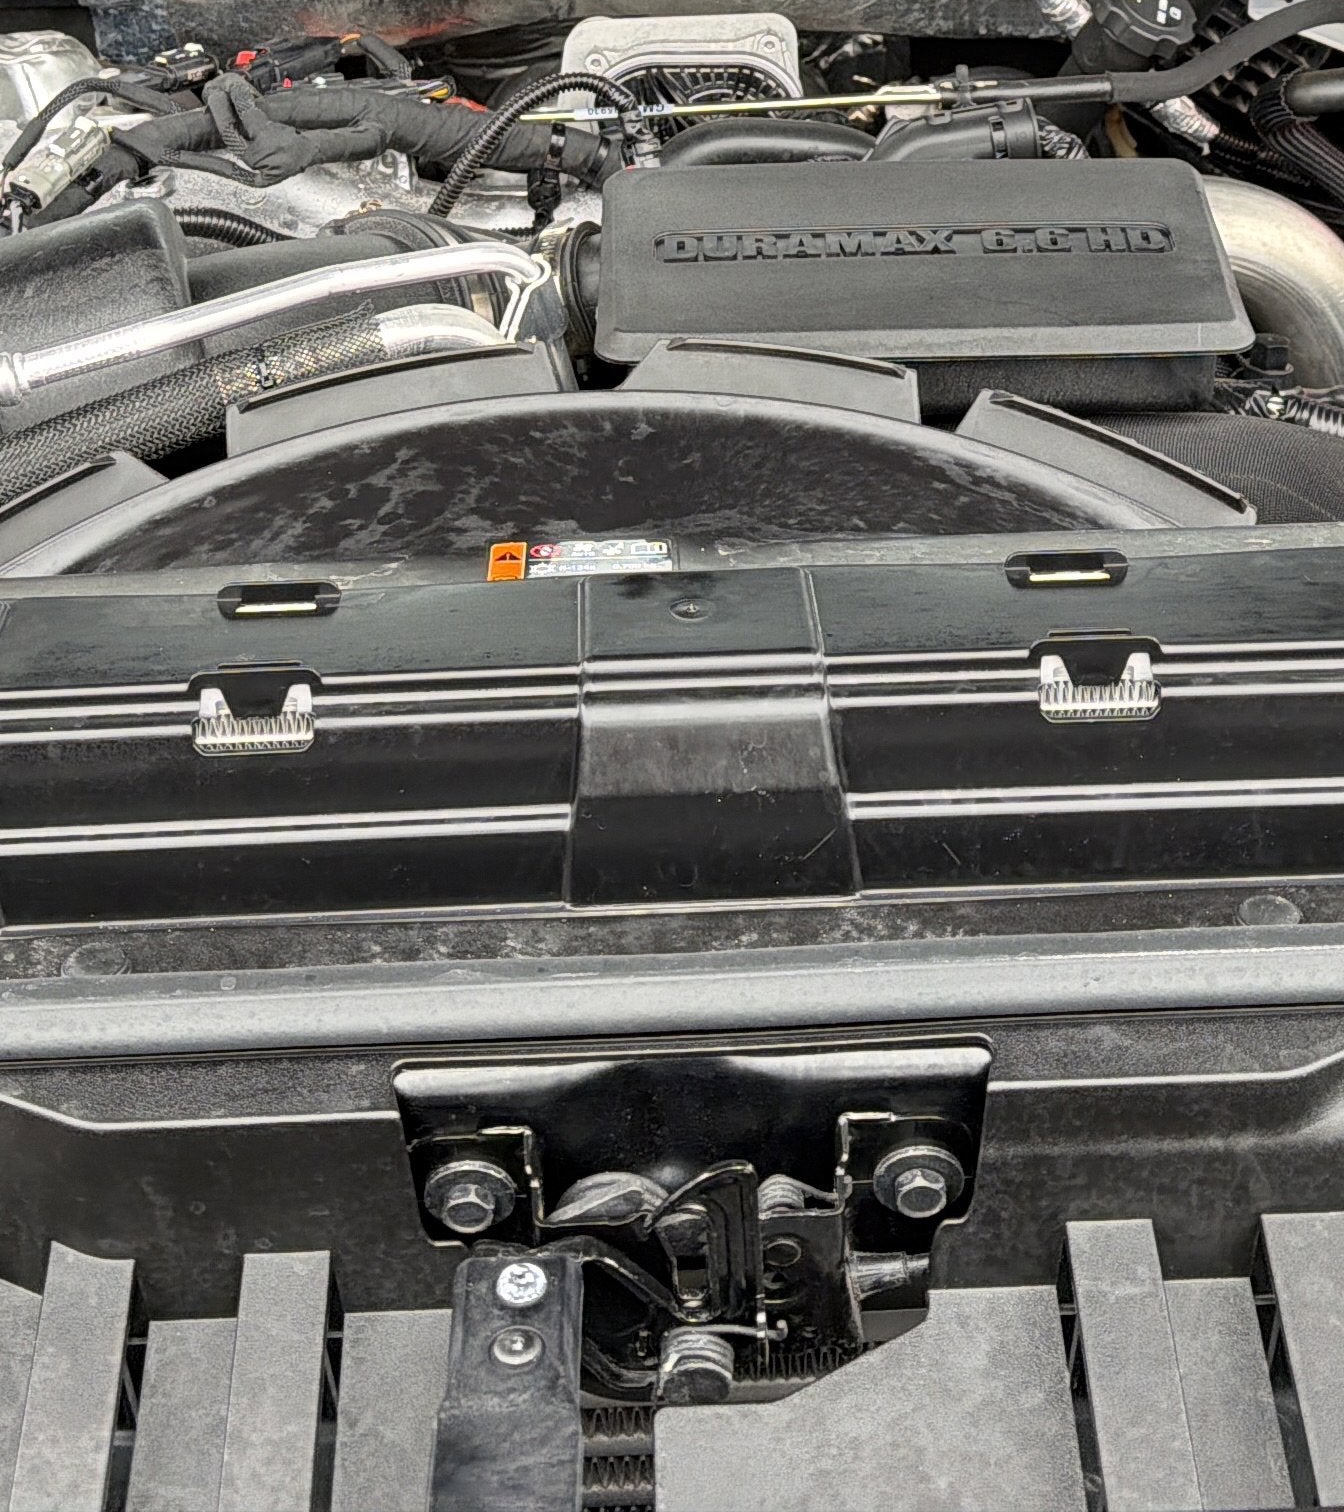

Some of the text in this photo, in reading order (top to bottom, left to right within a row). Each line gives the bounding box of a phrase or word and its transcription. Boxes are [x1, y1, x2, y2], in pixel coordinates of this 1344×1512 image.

[642, 104, 665, 113] GM
[662, 226, 1168, 263] DURAMAX 6.6 HD
